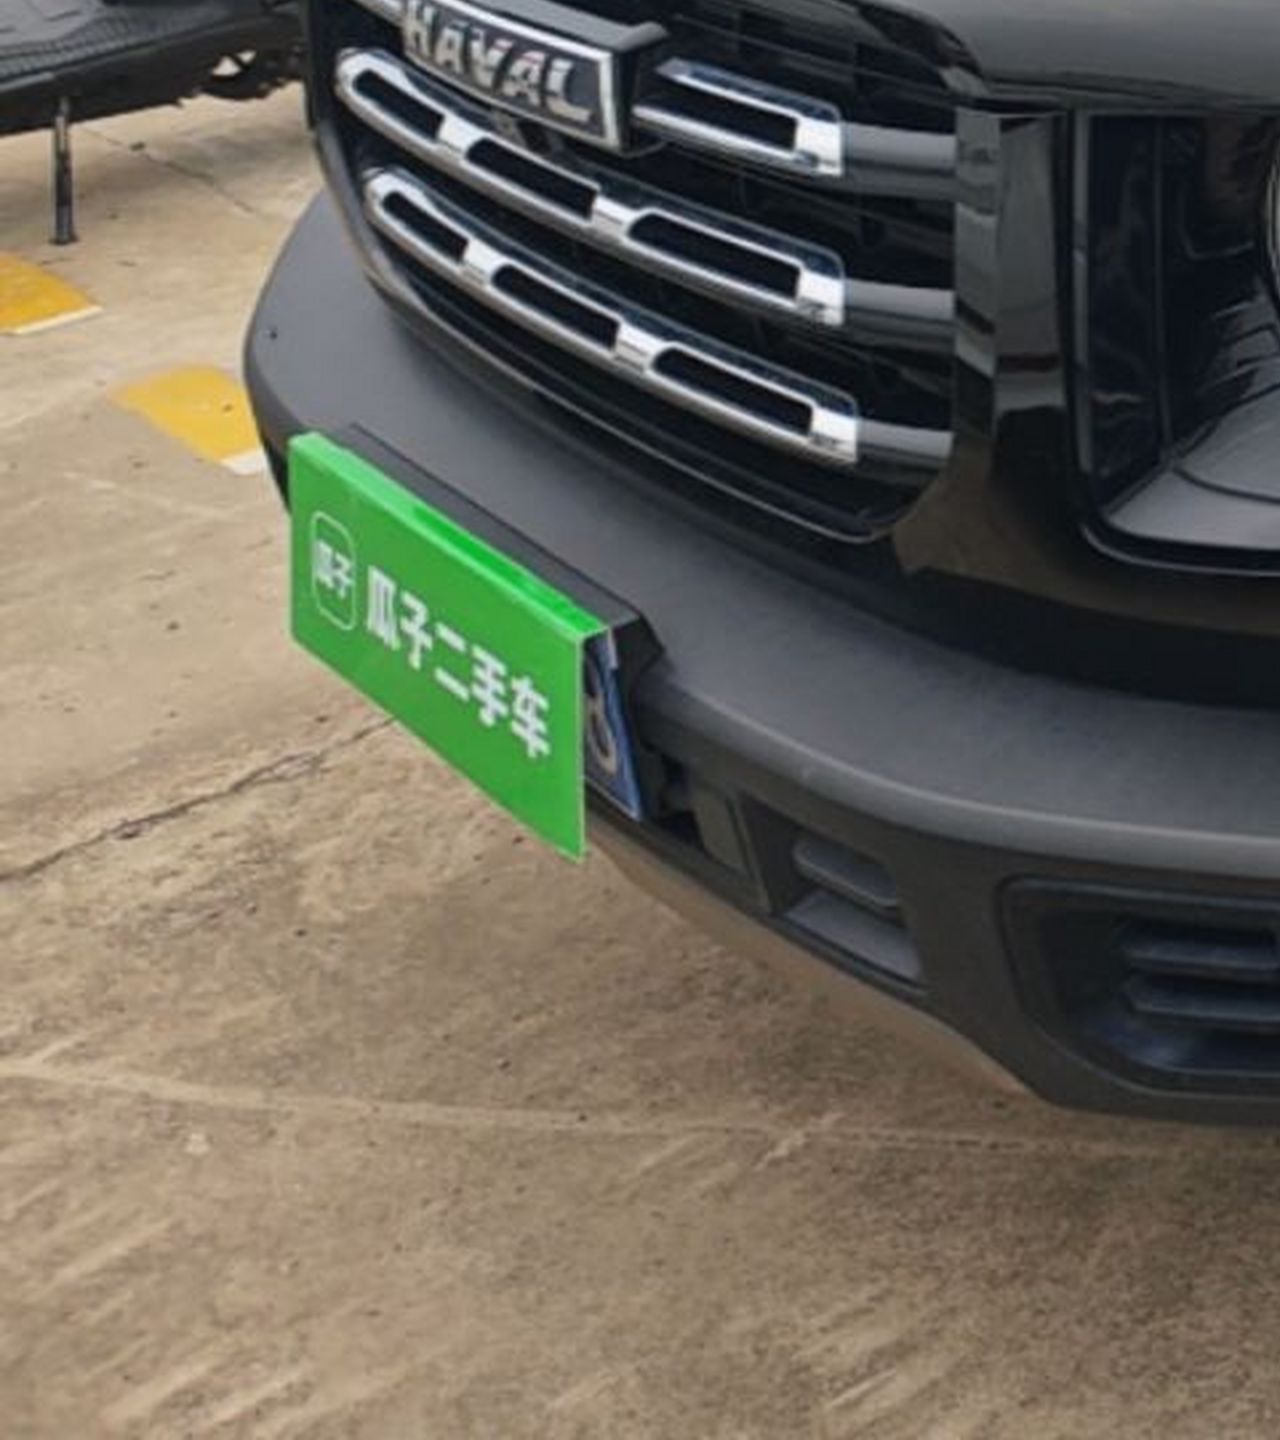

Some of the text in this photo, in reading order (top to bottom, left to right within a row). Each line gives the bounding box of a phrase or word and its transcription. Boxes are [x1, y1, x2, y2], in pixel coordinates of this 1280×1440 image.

[366, 563, 552, 760] 瓜子二手车
